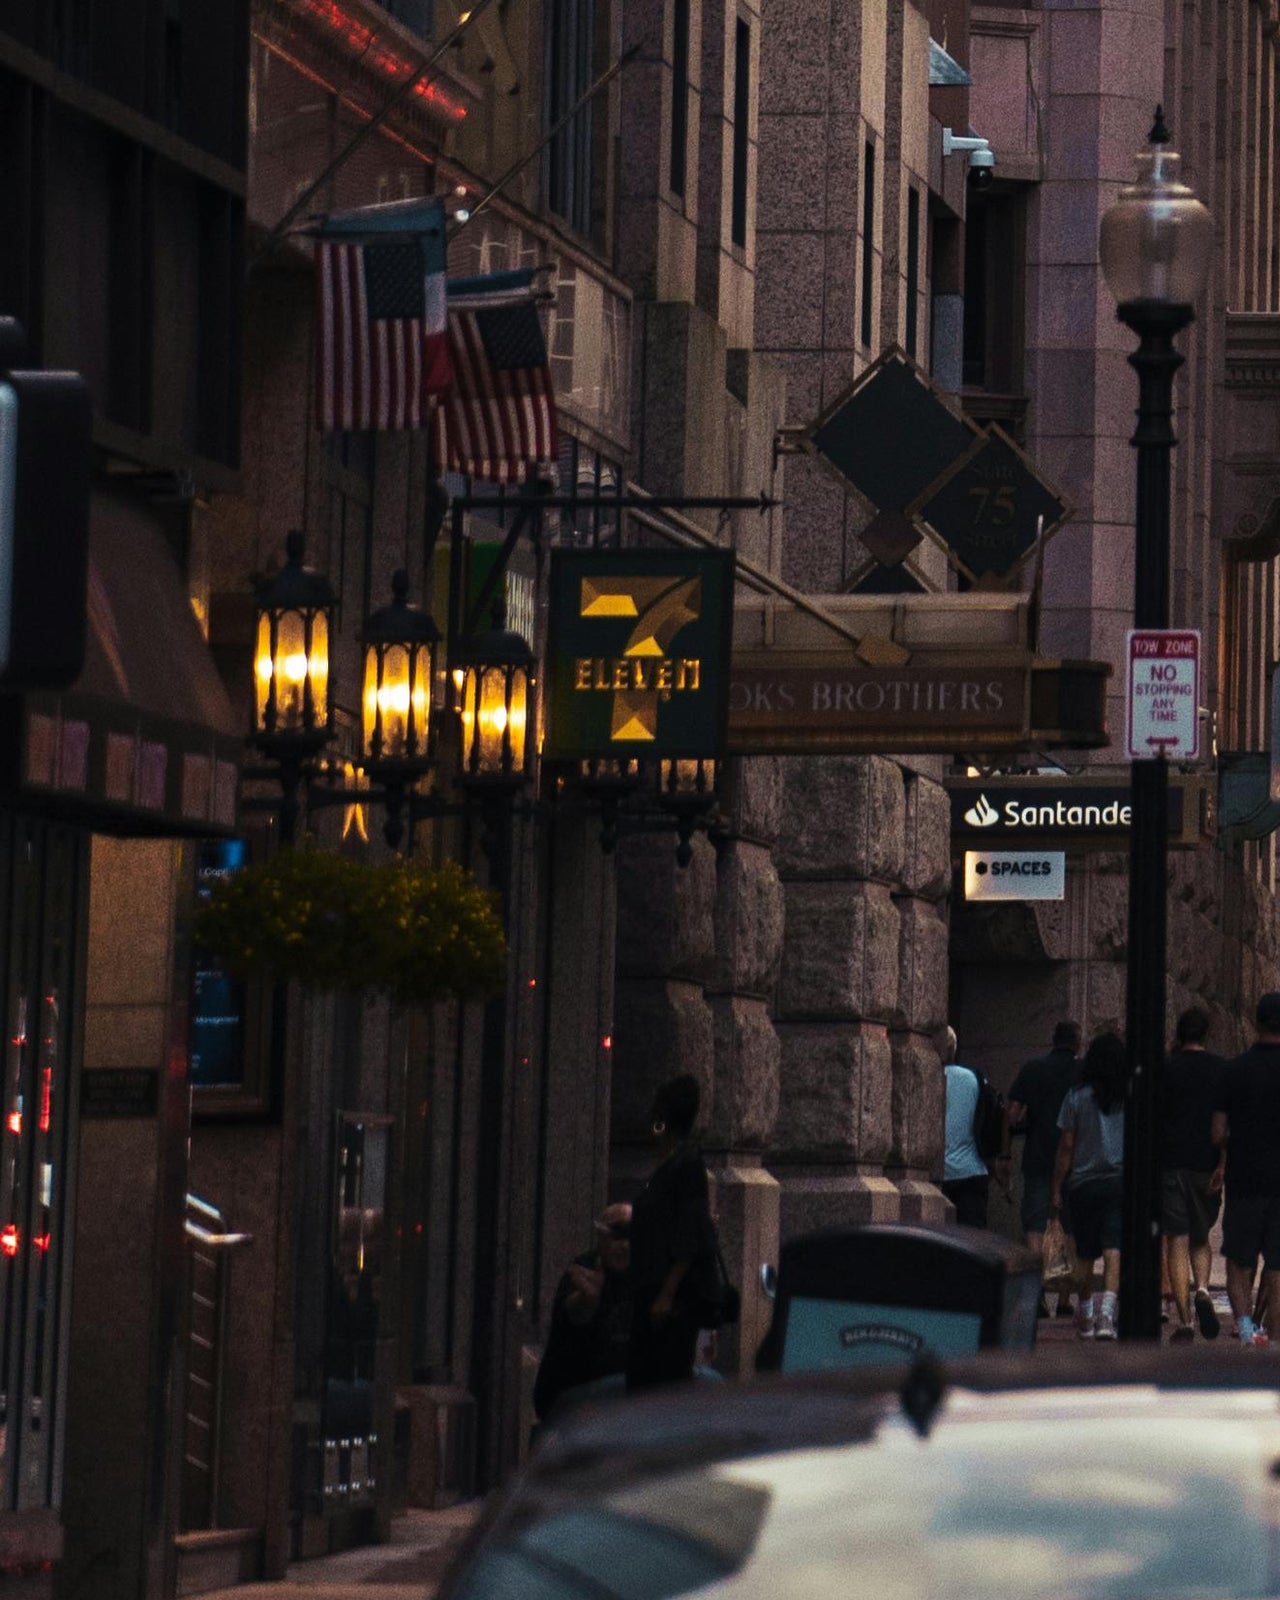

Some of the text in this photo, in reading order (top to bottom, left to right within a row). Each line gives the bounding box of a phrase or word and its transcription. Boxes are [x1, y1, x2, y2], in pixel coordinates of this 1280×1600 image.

[967, 486, 1017, 526] 75
[1135, 640, 1194, 654] TOW ZONE
[1150, 664, 1177, 681] NO
[812, 681, 1004, 711] BROTHERS
[1136, 683, 1192, 696] STOPPING
[1152, 699, 1175, 709] ANY
[1151, 710, 1178, 721] TIME
[1005, 801, 1132, 826] Santande
[991, 861, 1051, 875] SPACES
